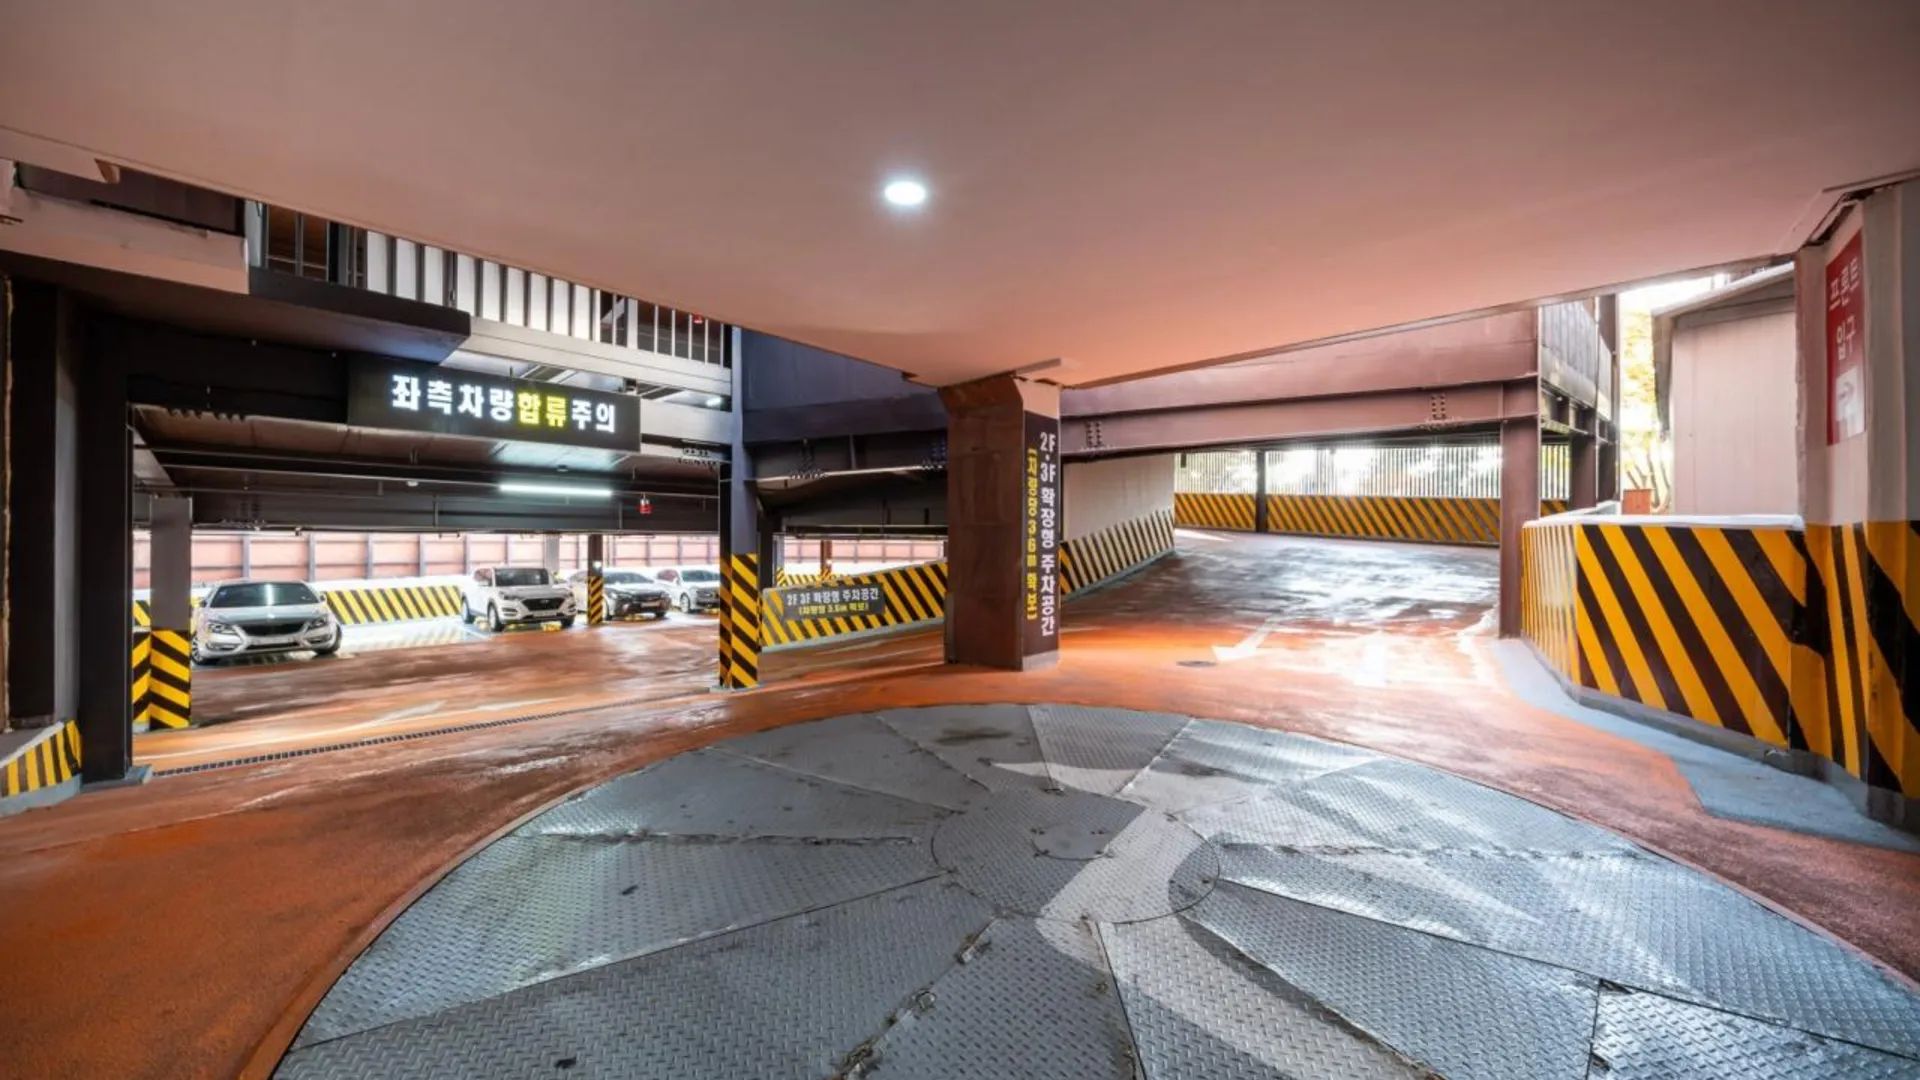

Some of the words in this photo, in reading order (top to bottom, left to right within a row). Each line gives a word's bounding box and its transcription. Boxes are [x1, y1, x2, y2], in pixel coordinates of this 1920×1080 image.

[1829, 256, 1860, 311] 프론트
[1836, 315, 1857, 362] 입구
[1041, 487, 1056, 549] 확장형
[842, 587, 879, 602] 주차공간
[1041, 554, 1056, 637] 주차공간
